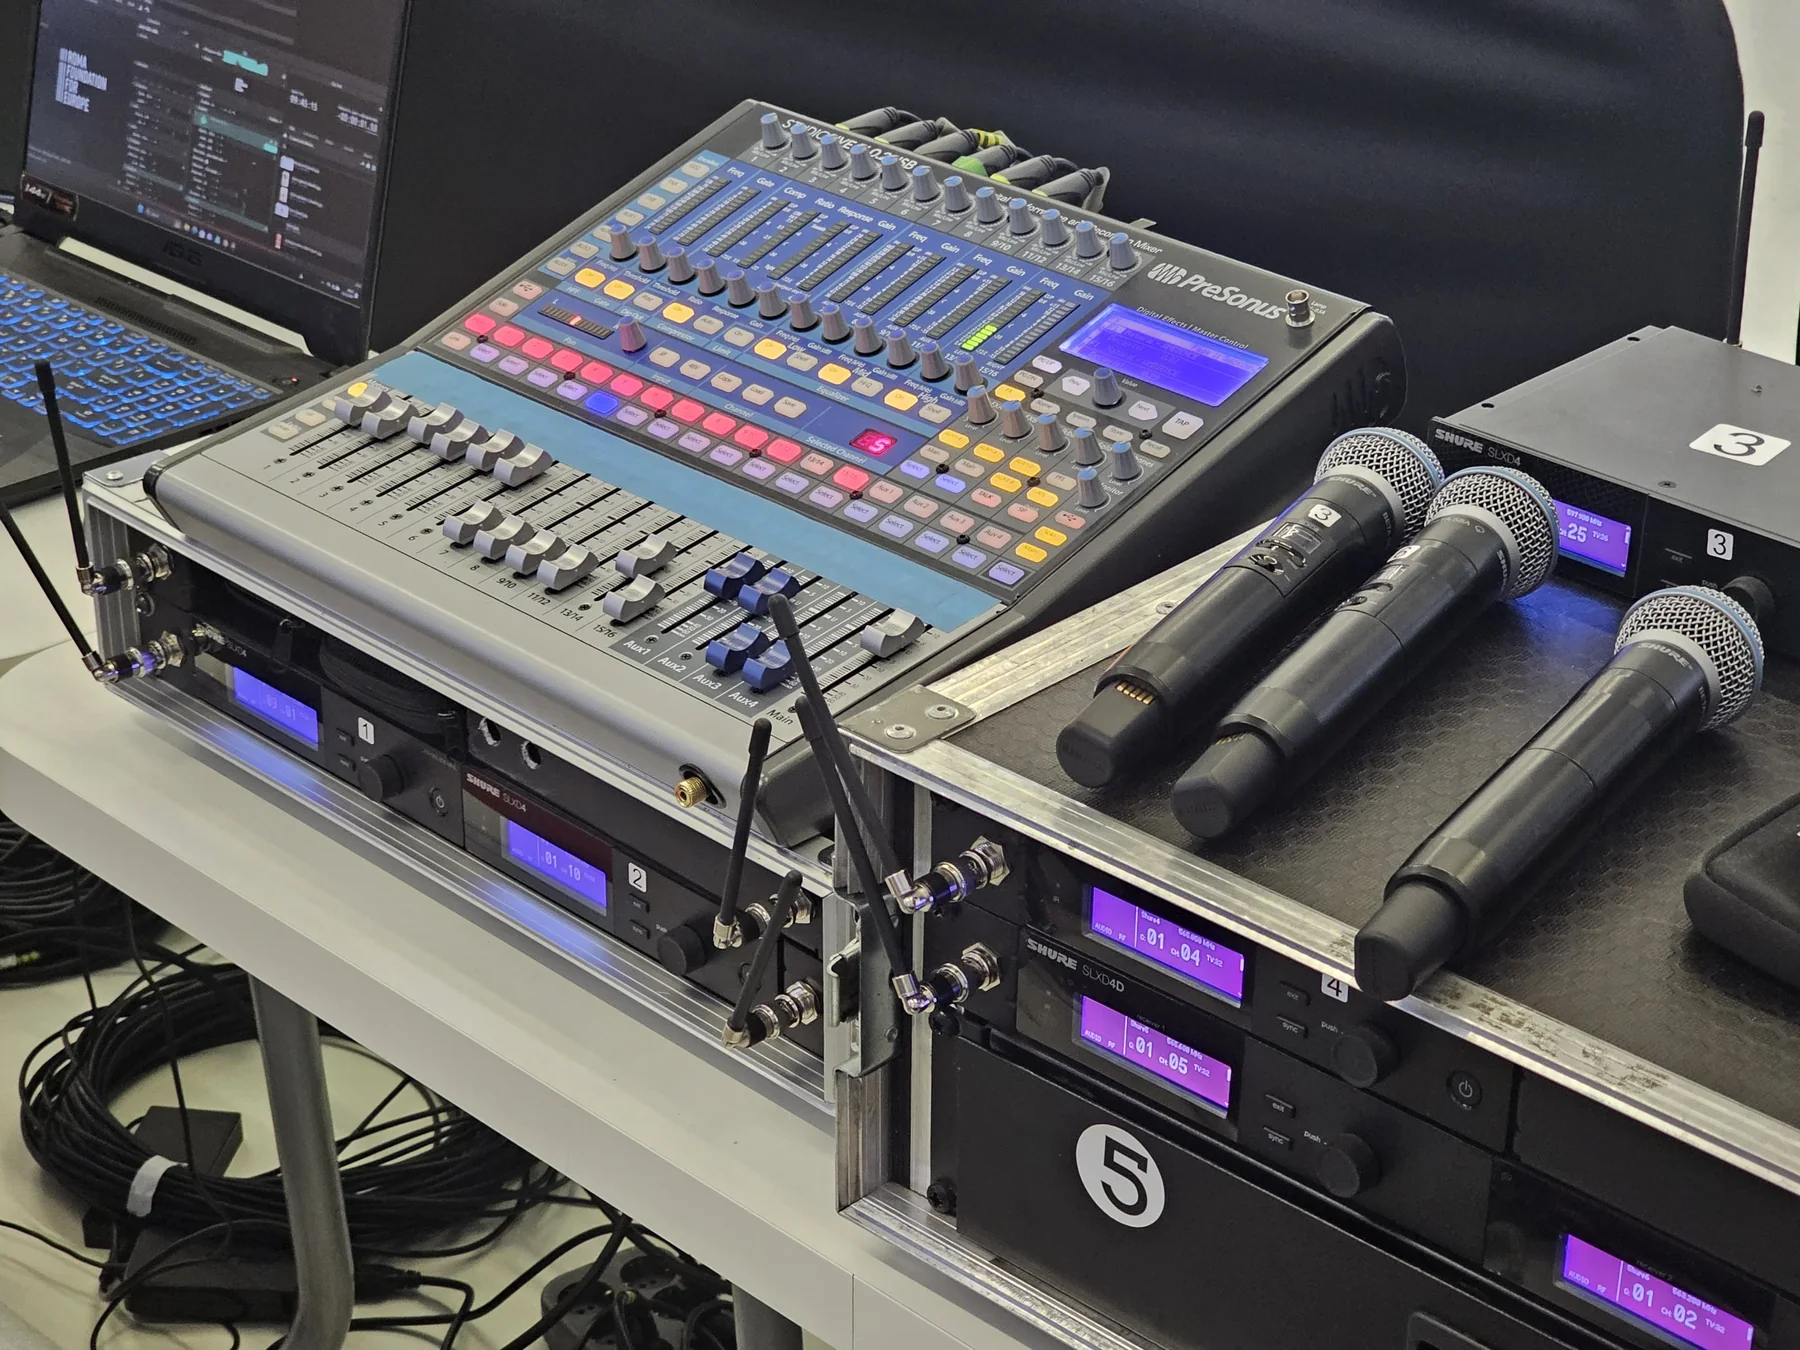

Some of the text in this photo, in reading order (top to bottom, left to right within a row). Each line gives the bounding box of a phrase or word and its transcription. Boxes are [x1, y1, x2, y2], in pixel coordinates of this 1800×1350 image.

[784, 187, 806, 199] Comp
[877, 219, 897, 231] Gain
[908, 230, 928, 243] Freq
[940, 242, 960, 254] Gain
[973, 253, 993, 266] Freq
[1021, 251, 1048, 264] 11/12
[1006, 265, 1026, 277] Gain
[1055, 263, 1081, 276] 13/14
[1039, 277, 1060, 290] Freq
[1089, 274, 1117, 288] 15/16
[1073, 289, 1094, 301] Gain
[1177, 274, 1288, 321] PreSonus
[1136, 306, 1249, 351] Digital Effects Master Control
[1175, 418, 1190, 427] TAP
[805, 435, 868, 465] Selected Channel
[1434, 428, 1521, 467] SHURE SLXD4
[1713, 432, 1765, 457] 3
[1314, 507, 1332, 521] 3
[1567, 523, 1588, 543] 25
[1713, 533, 1727, 556] 3
[527, 592, 551, 606] 11/12
[560, 607, 584, 622] 13/14
[592, 624, 618, 639] 15/16
[623, 639, 651, 656] Aux1
[1637, 642, 1688, 669] SHURE
[657, 656, 688, 674] Aux2
[692, 673, 723, 691] Aux3
[728, 691, 759, 709] Aux4
[766, 708, 794, 726] Main
[466, 773, 501, 798] SHURE
[545, 851, 581, 881] 01 10
[632, 868, 643, 889] 2
[1146, 927, 1165, 950] 01
[1180, 943, 1201, 967] 04
[1026, 937, 1125, 993] SHURE SLXD4D
[1326, 976, 1342, 998] 4
[1281, 1020, 1299, 1034] sync
[1320, 1020, 1339, 1033] push
[1135, 1036, 1153, 1058] 01
[1168, 1052, 1188, 1076] 05
[1272, 1102, 1285, 1113] exit
[1267, 1132, 1285, 1146] sync
[1303, 1129, 1322, 1144] push
[1100, 1134, 1149, 1217] 5
[1631, 1282, 1654, 1308] 01
[1673, 1303, 1699, 1331] 02
